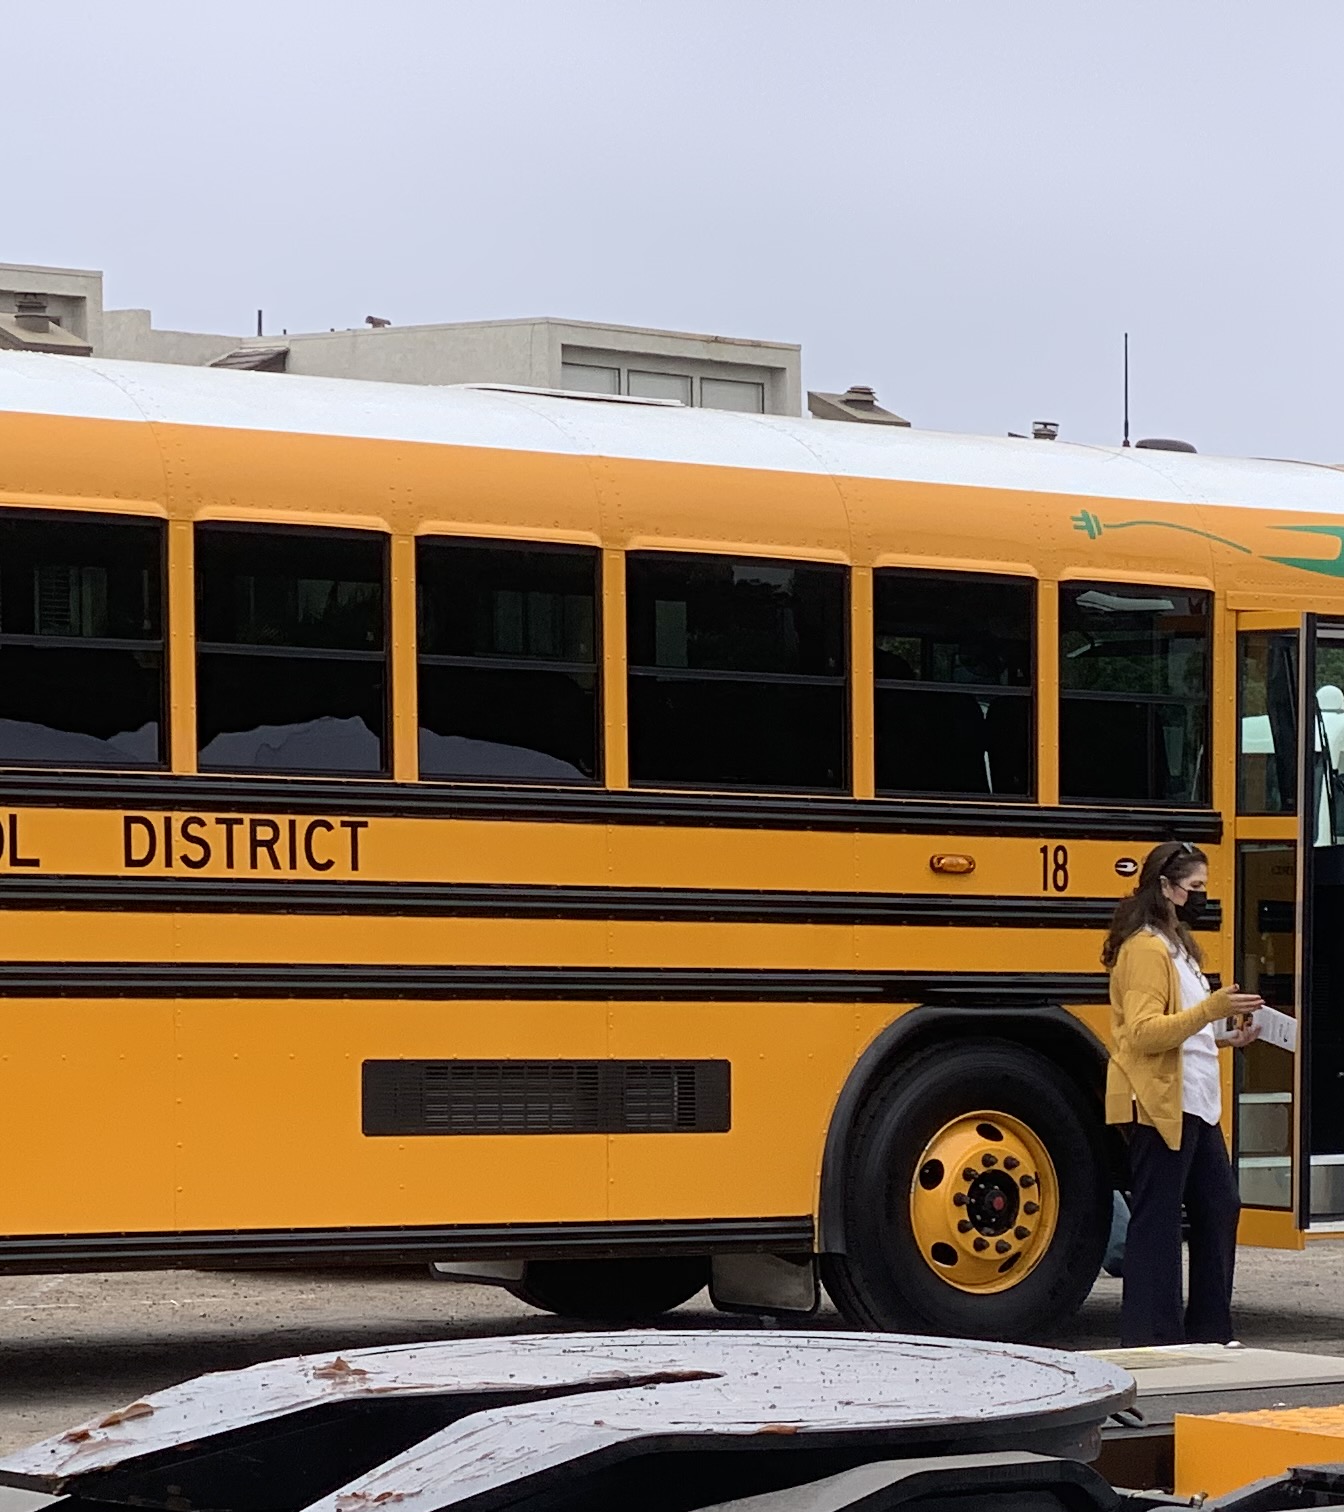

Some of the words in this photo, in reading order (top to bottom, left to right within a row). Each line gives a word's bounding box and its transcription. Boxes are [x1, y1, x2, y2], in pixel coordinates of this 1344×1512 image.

[0, 814, 40, 867] L
[124, 815, 369, 872] DISTRICT
[1039, 844, 1069, 892] 18
